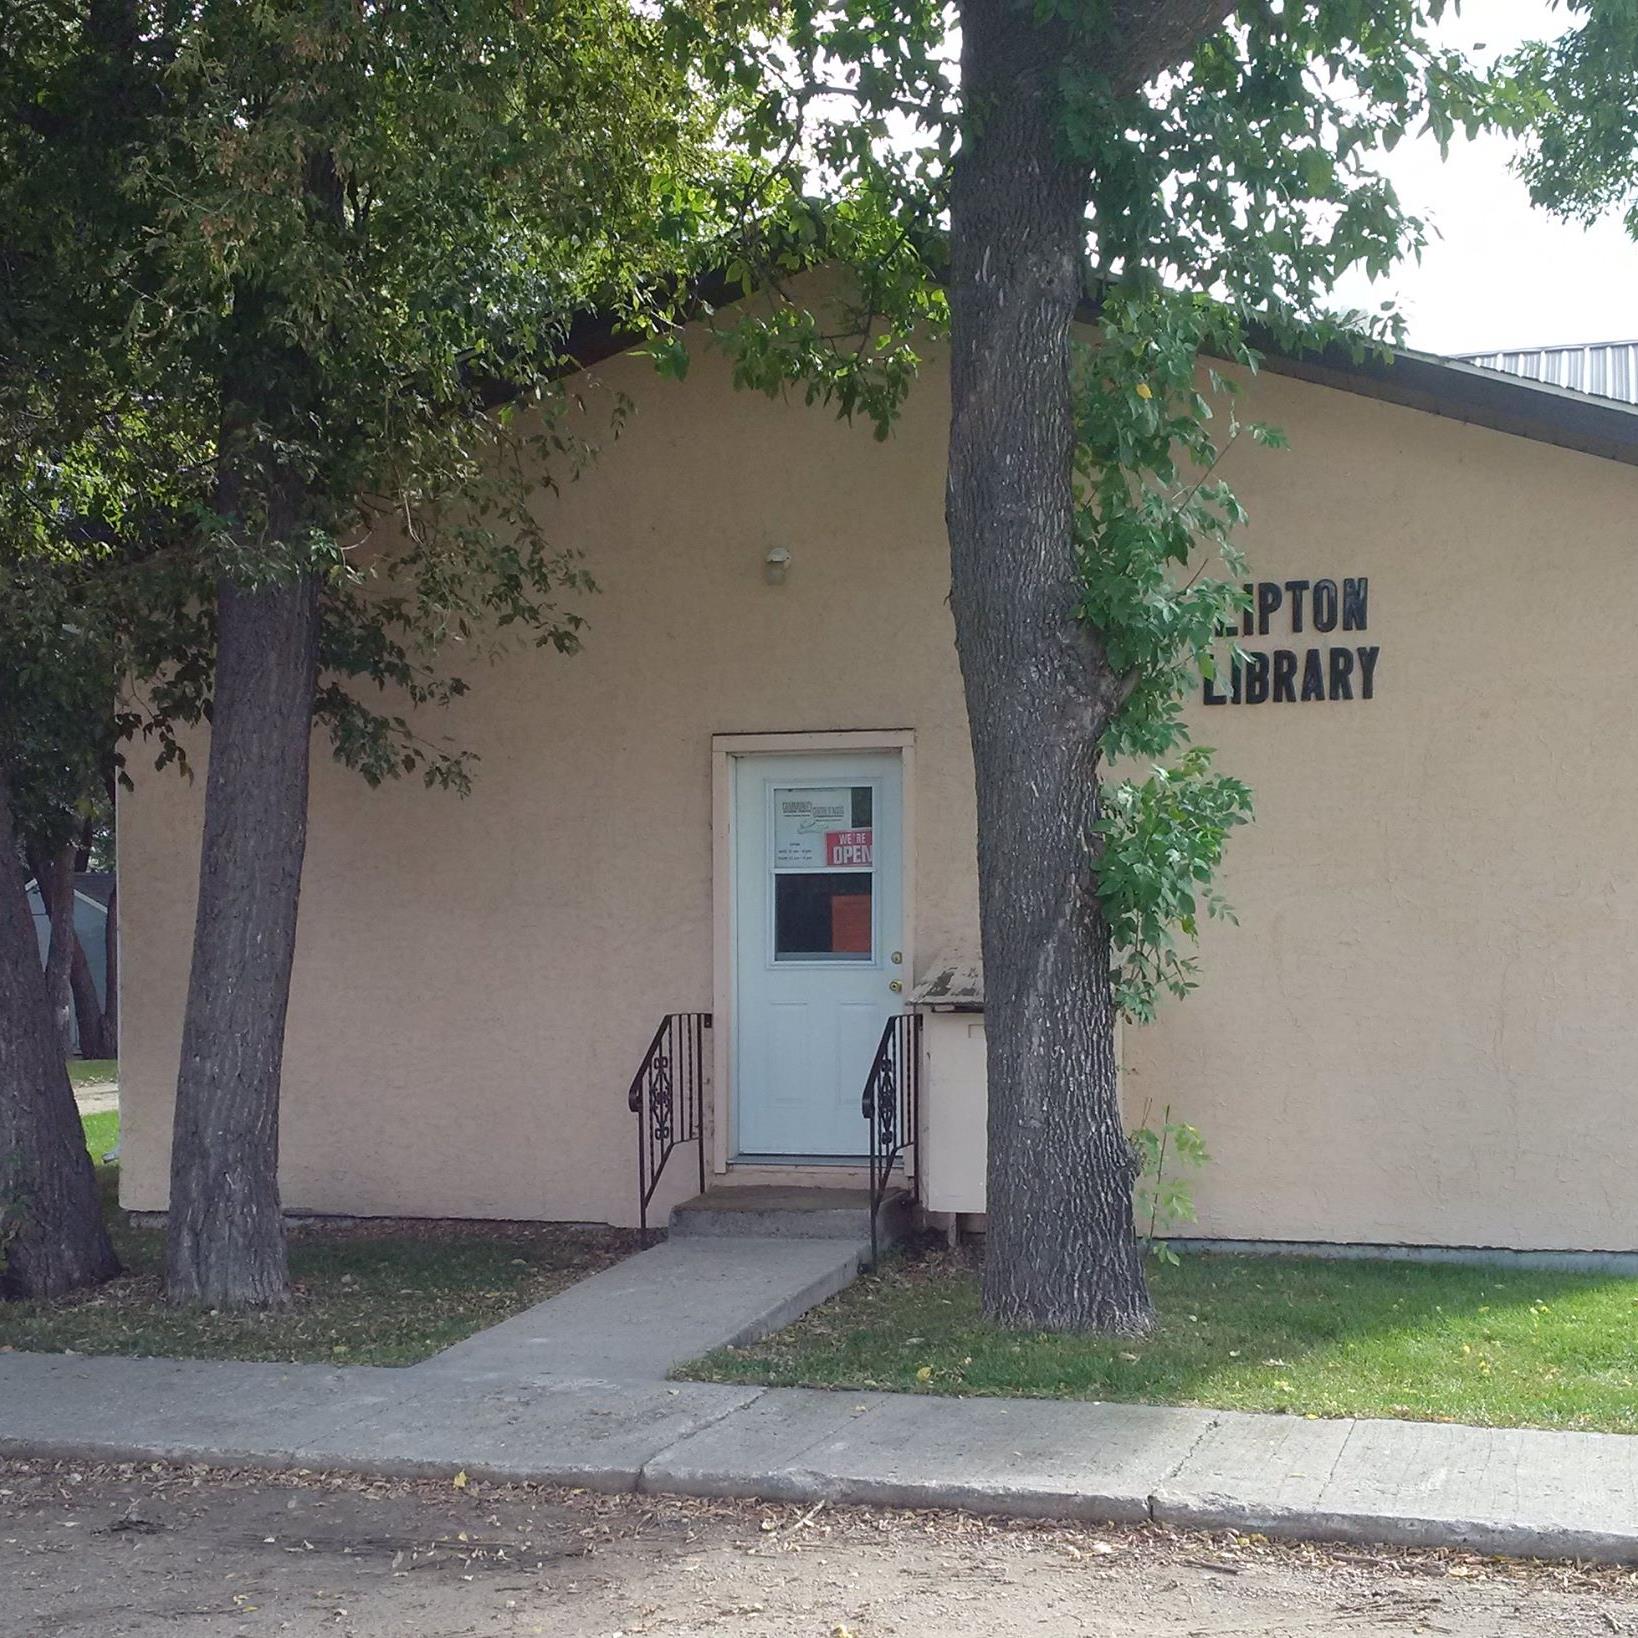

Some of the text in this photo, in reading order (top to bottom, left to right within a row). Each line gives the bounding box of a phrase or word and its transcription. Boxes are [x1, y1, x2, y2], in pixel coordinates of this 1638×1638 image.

[1203, 646, 1380, 705] LIBRARY
[838, 832, 866, 845] WE'RE
[833, 845, 872, 865] OPEN
